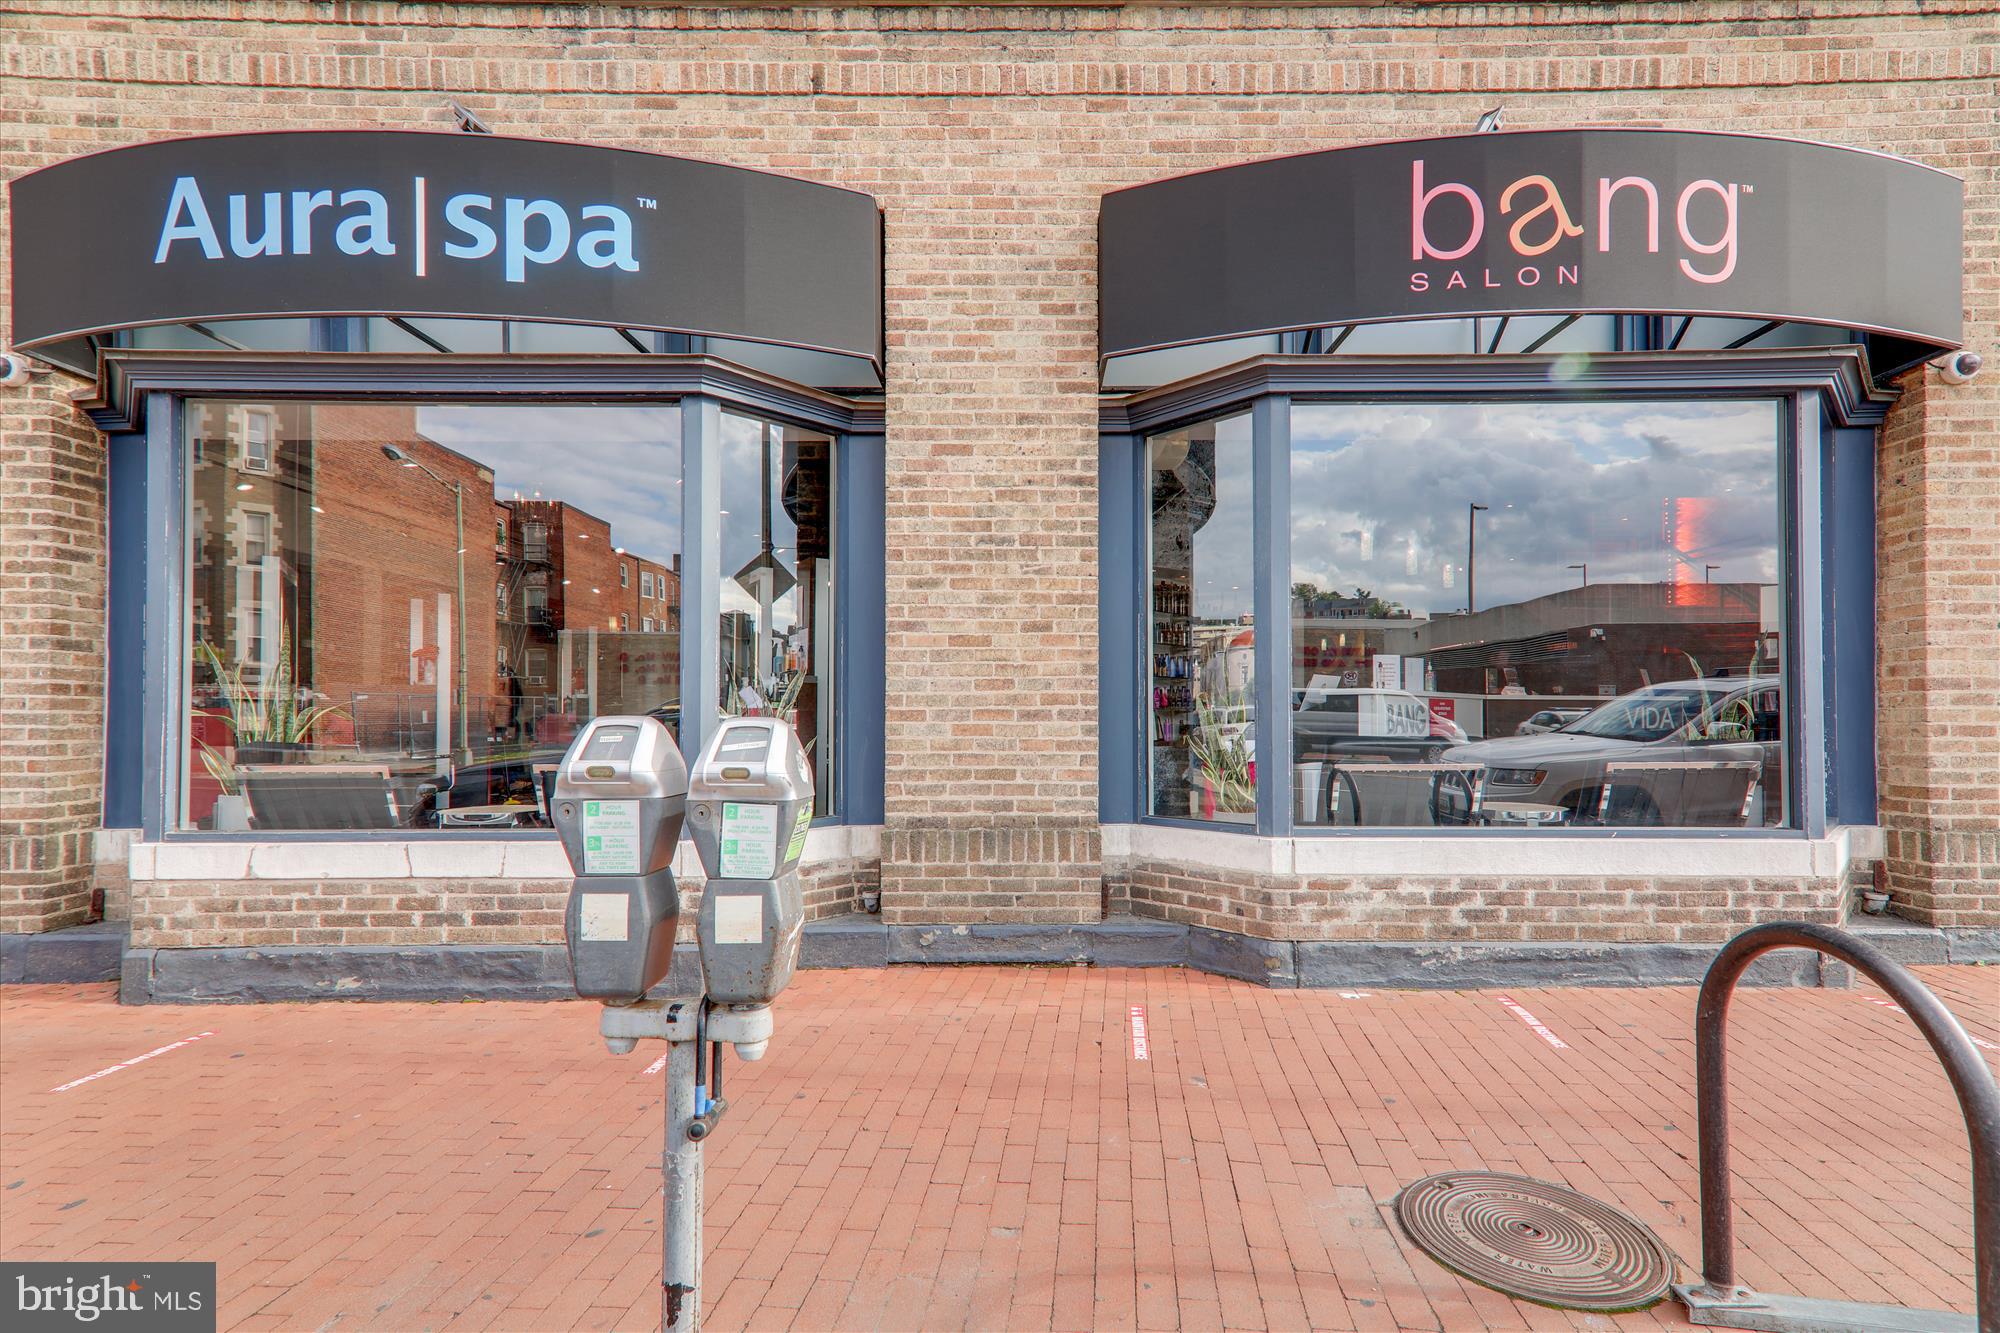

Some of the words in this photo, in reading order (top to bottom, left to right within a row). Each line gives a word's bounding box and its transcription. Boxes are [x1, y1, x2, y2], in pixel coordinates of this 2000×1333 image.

[154, 176, 396, 264] Aura
[444, 193, 640, 283] spa
[1412, 159, 1738, 284] bang
[1409, 265, 1579, 292] SALON
[1386, 703, 1427, 735] BANG
[1625, 706, 1676, 729] VIDA
[1493, 1252, 1553, 1274] WATER
